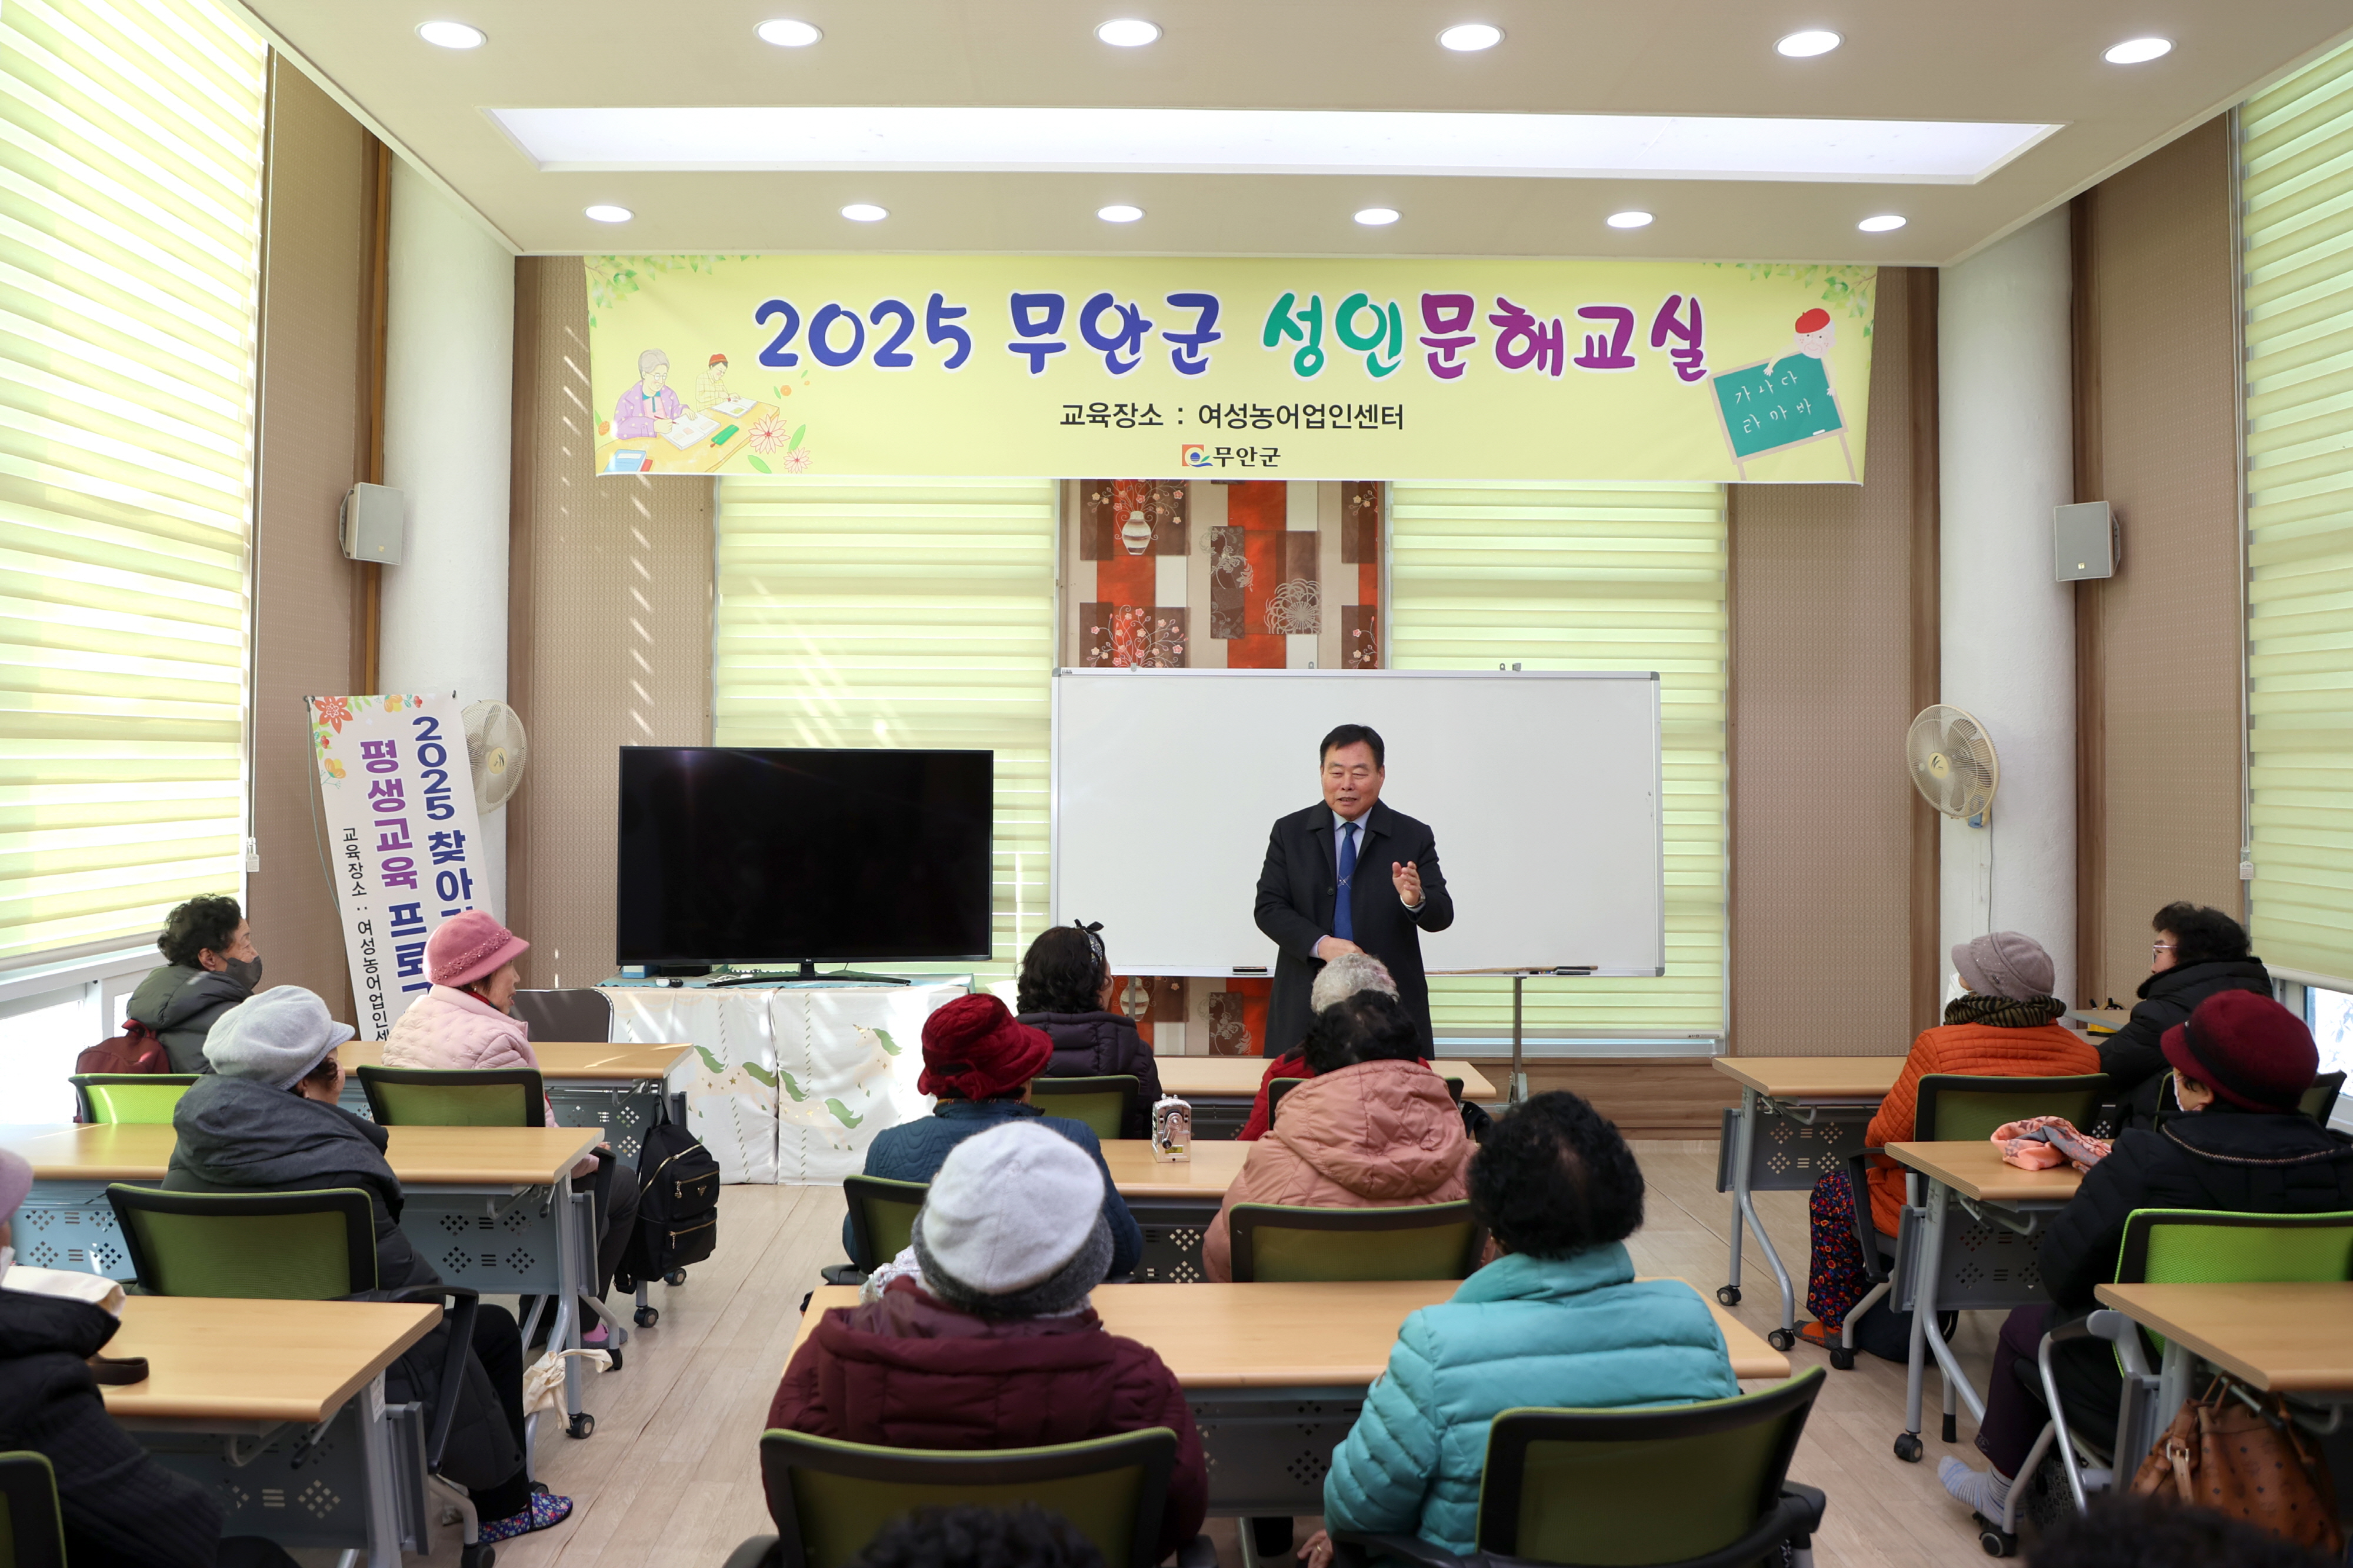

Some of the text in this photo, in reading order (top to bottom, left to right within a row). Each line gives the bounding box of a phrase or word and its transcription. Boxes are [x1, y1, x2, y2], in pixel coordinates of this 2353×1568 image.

[755, 292, 972, 370] 2025
[1008, 292, 1223, 376] 무안군
[1059, 402, 1164, 429] 교육장소
[1198, 403, 1404, 430] 여성농어업인센터
[1213, 446, 1281, 468] 무안군
[412, 716, 455, 821] 2025
[360, 739, 418, 890] 평생교육
[343, 828, 367, 896] 교육장소
